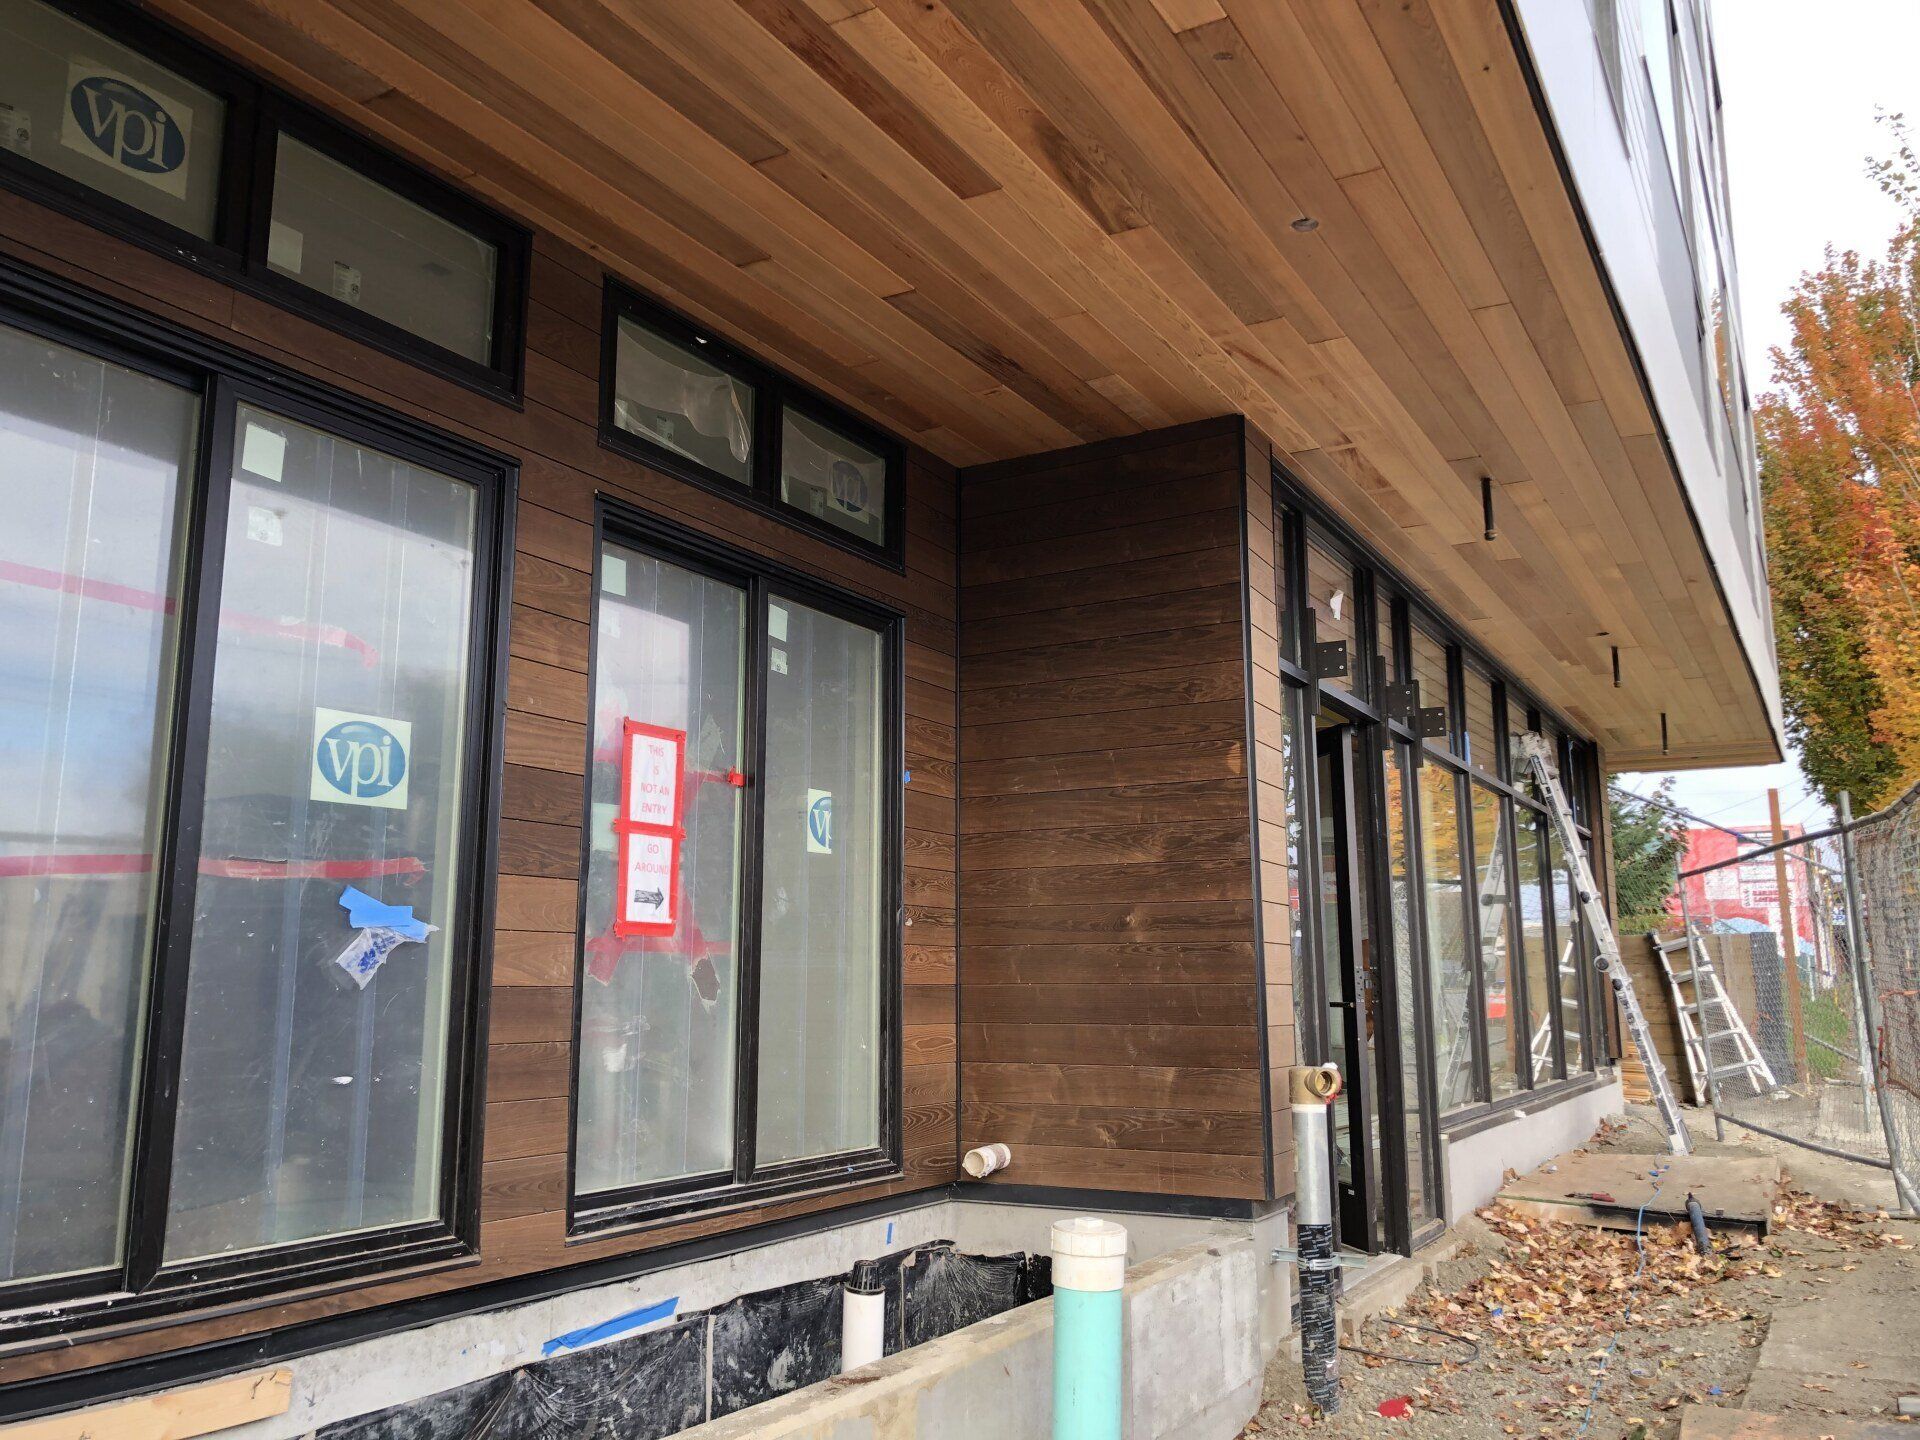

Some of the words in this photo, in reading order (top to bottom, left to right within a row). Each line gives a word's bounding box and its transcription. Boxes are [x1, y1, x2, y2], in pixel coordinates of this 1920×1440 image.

[82, 84, 169, 169] vpi
[648, 744, 664, 757] THIS
[325, 735, 393, 796] vpi
[652, 765, 659, 775] IS
[641, 782, 657, 793] NOT
[659, 785, 669, 796] AN
[641, 802, 667, 814] ENTRY
[647, 843, 659, 854] GO
[634, 861, 669, 875] AROUND
